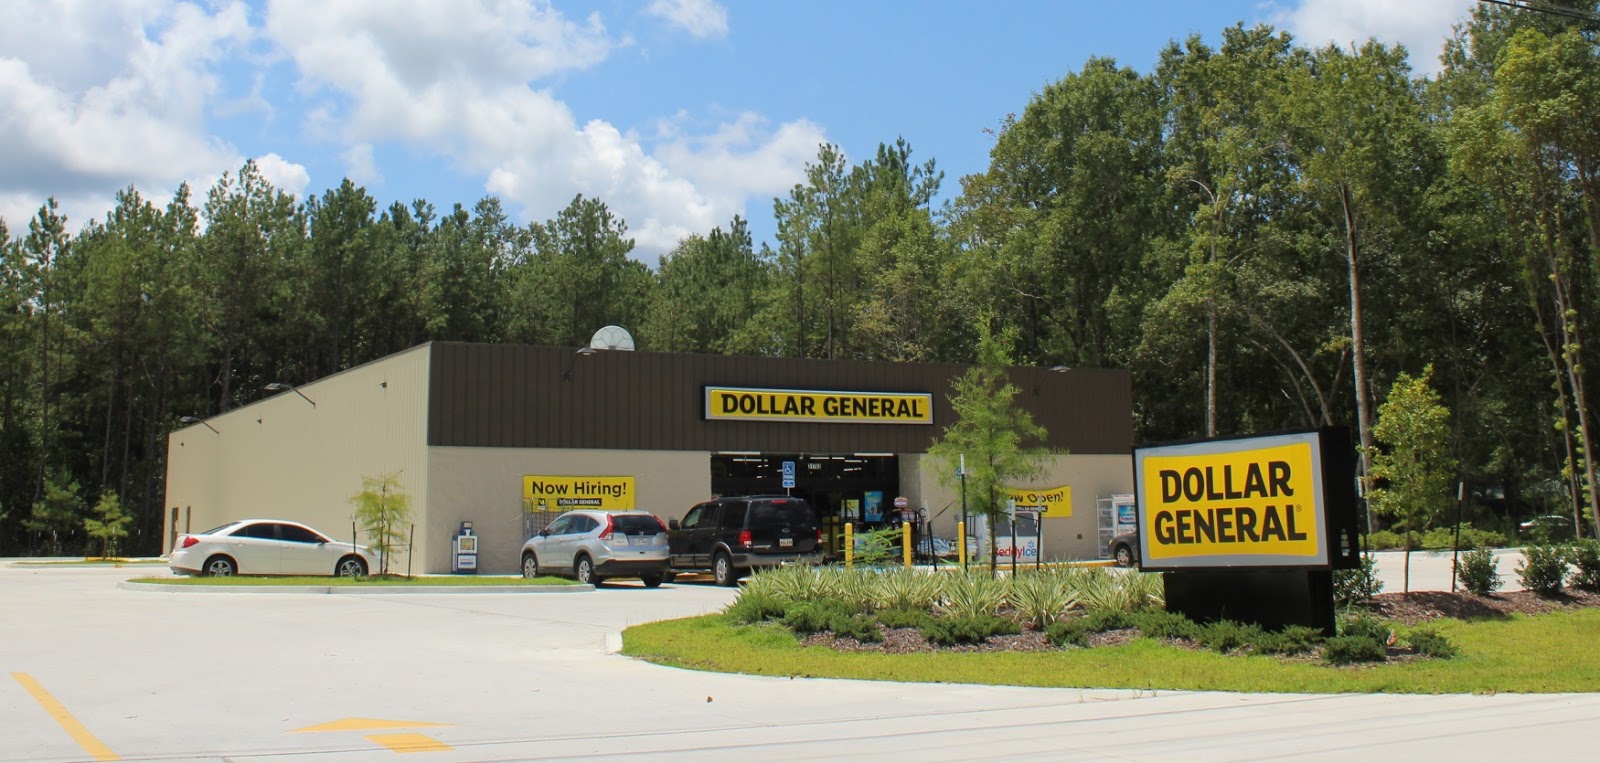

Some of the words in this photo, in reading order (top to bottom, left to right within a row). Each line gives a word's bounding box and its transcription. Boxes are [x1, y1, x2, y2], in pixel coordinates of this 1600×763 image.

[721, 393, 816, 416] DOLLAR
[822, 396, 923, 418] GENERAL
[532, 481, 569, 494] Now
[574, 481, 627, 498] Hiring!
[1159, 460, 1294, 503] DOLLAR
[1154, 504, 1307, 545] GENERAL
